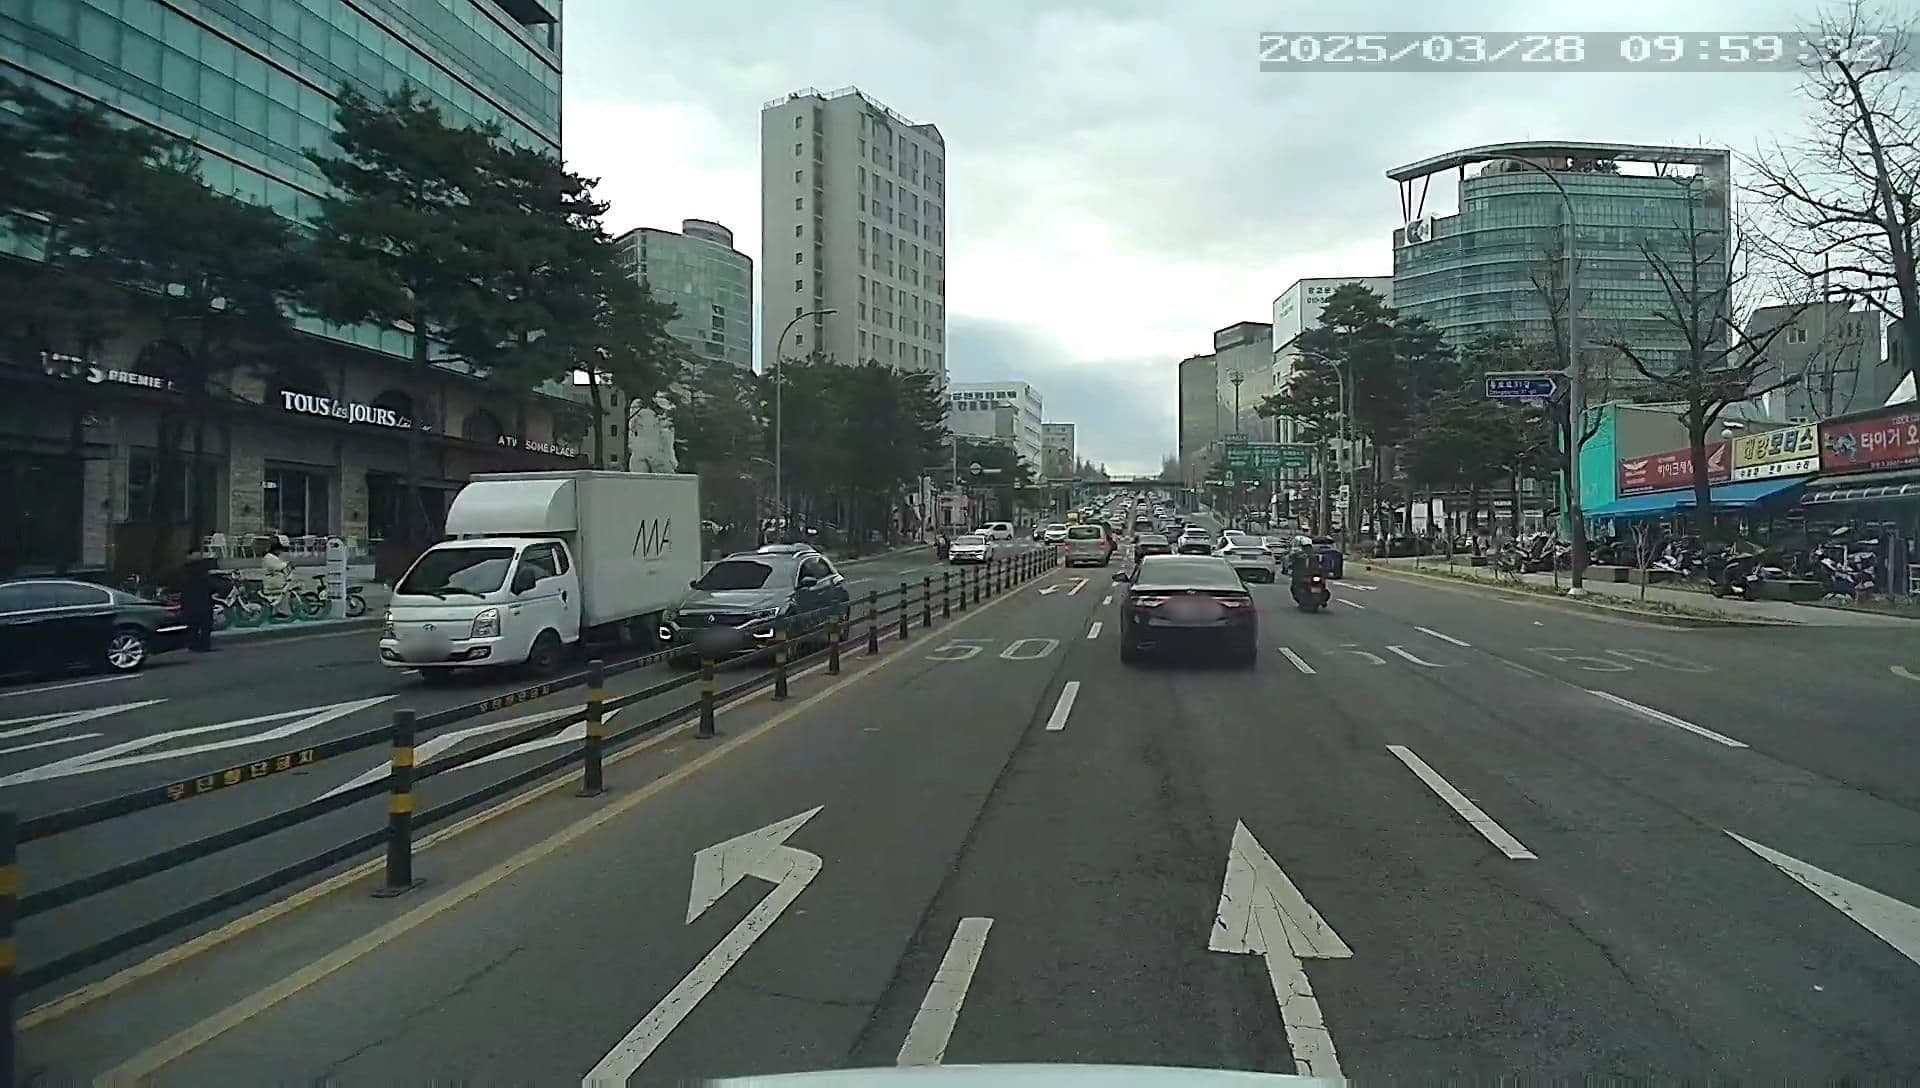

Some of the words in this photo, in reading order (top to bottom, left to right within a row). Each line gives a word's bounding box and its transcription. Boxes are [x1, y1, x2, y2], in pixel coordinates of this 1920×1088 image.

[281, 391, 330, 416] TOUS
[331, 400, 348, 419] les
[348, 403, 396, 427] JOURS
[1861, 427, 1901, 452] 타이거
